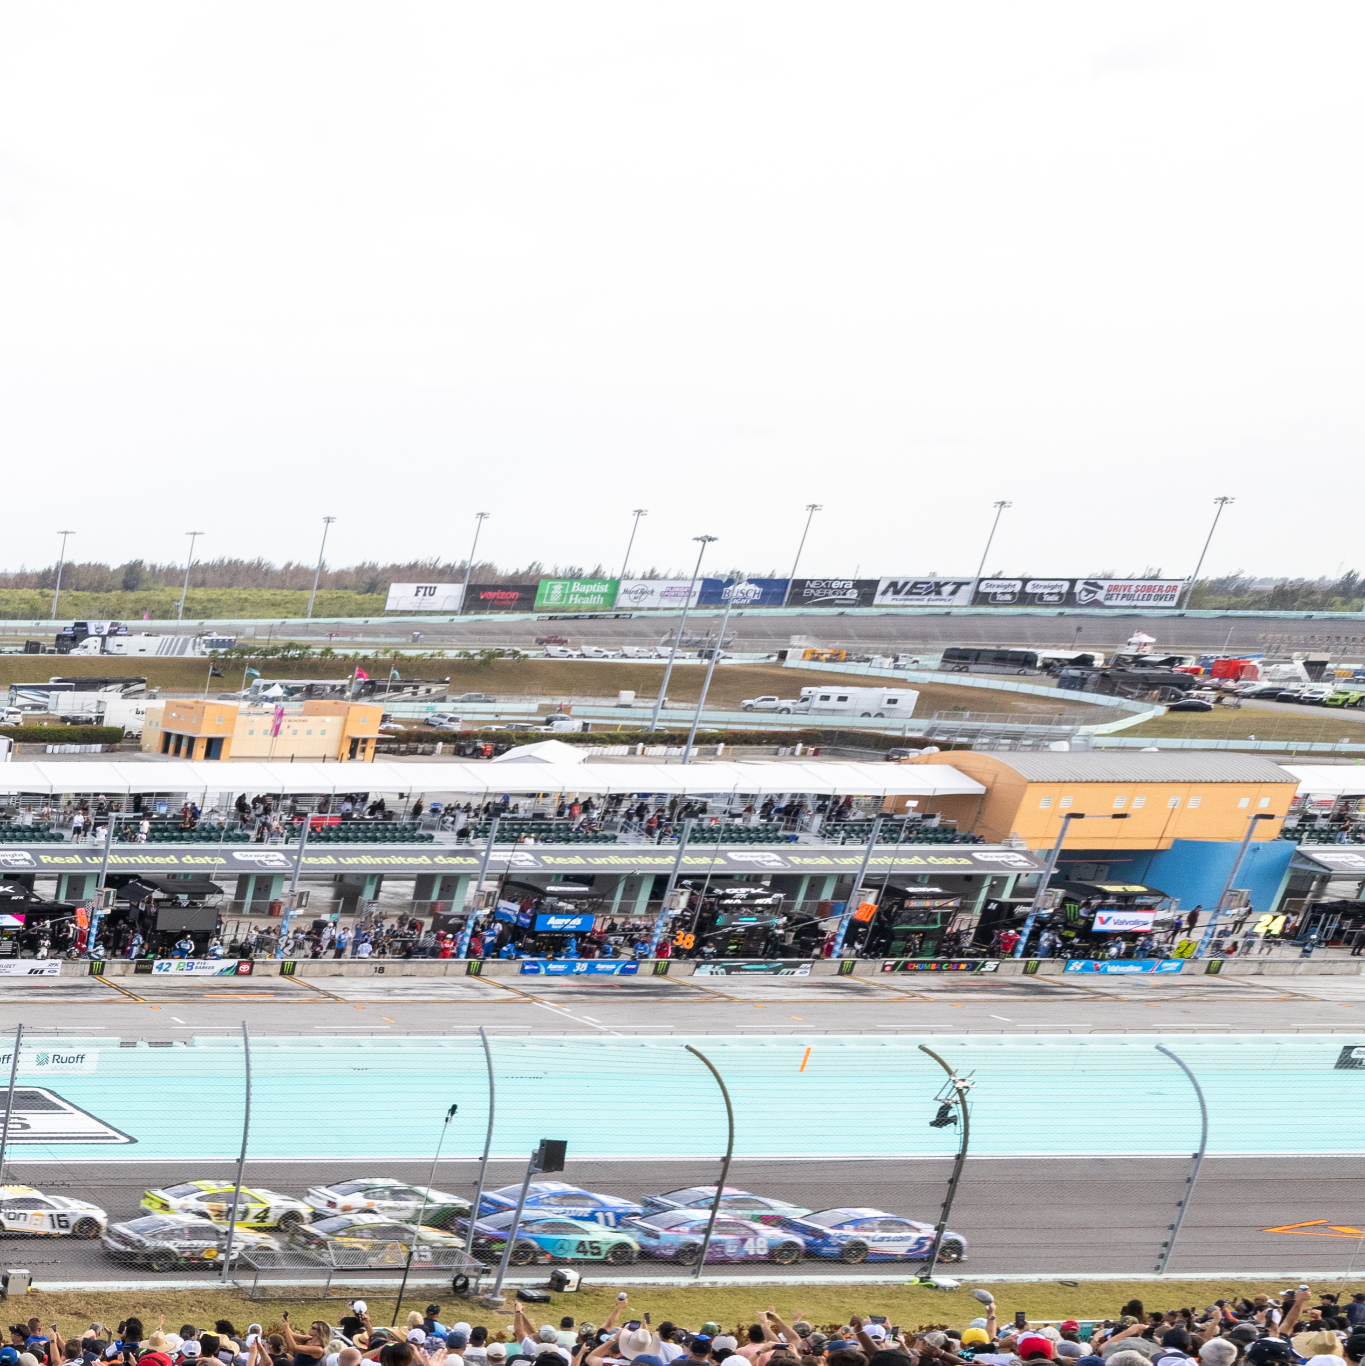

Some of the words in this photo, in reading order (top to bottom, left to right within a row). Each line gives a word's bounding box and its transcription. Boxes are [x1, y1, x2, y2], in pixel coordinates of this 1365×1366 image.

[414, 586, 437, 597] FIU
[880, 581, 971, 597] NEXT
[1107, 584, 1133, 593] DRIVE
[1134, 584, 1163, 593] SOBER
[1165, 585, 1178, 593] OR
[480, 590, 519, 600] verizon
[1104, 593, 1120, 602] GET
[1122, 593, 1153, 602] PULLED
[1156, 593, 1177, 602] OVER
[1112, 917, 1149, 925] Valvoline
[1253, 914, 1286, 934] 24
[673, 931, 695, 949] 38
[155, 962, 172, 971] 42
[374, 966, 385, 974] 18
[573, 963, 588, 973] 38
[980, 962, 998, 971] 35
[254, 1207, 271, 1223] 4
[596, 1212, 615, 1227] 11
[49, 1213, 69, 1229] 16
[576, 1240, 602, 1256] 45
[744, 1239, 768, 1255] 48
